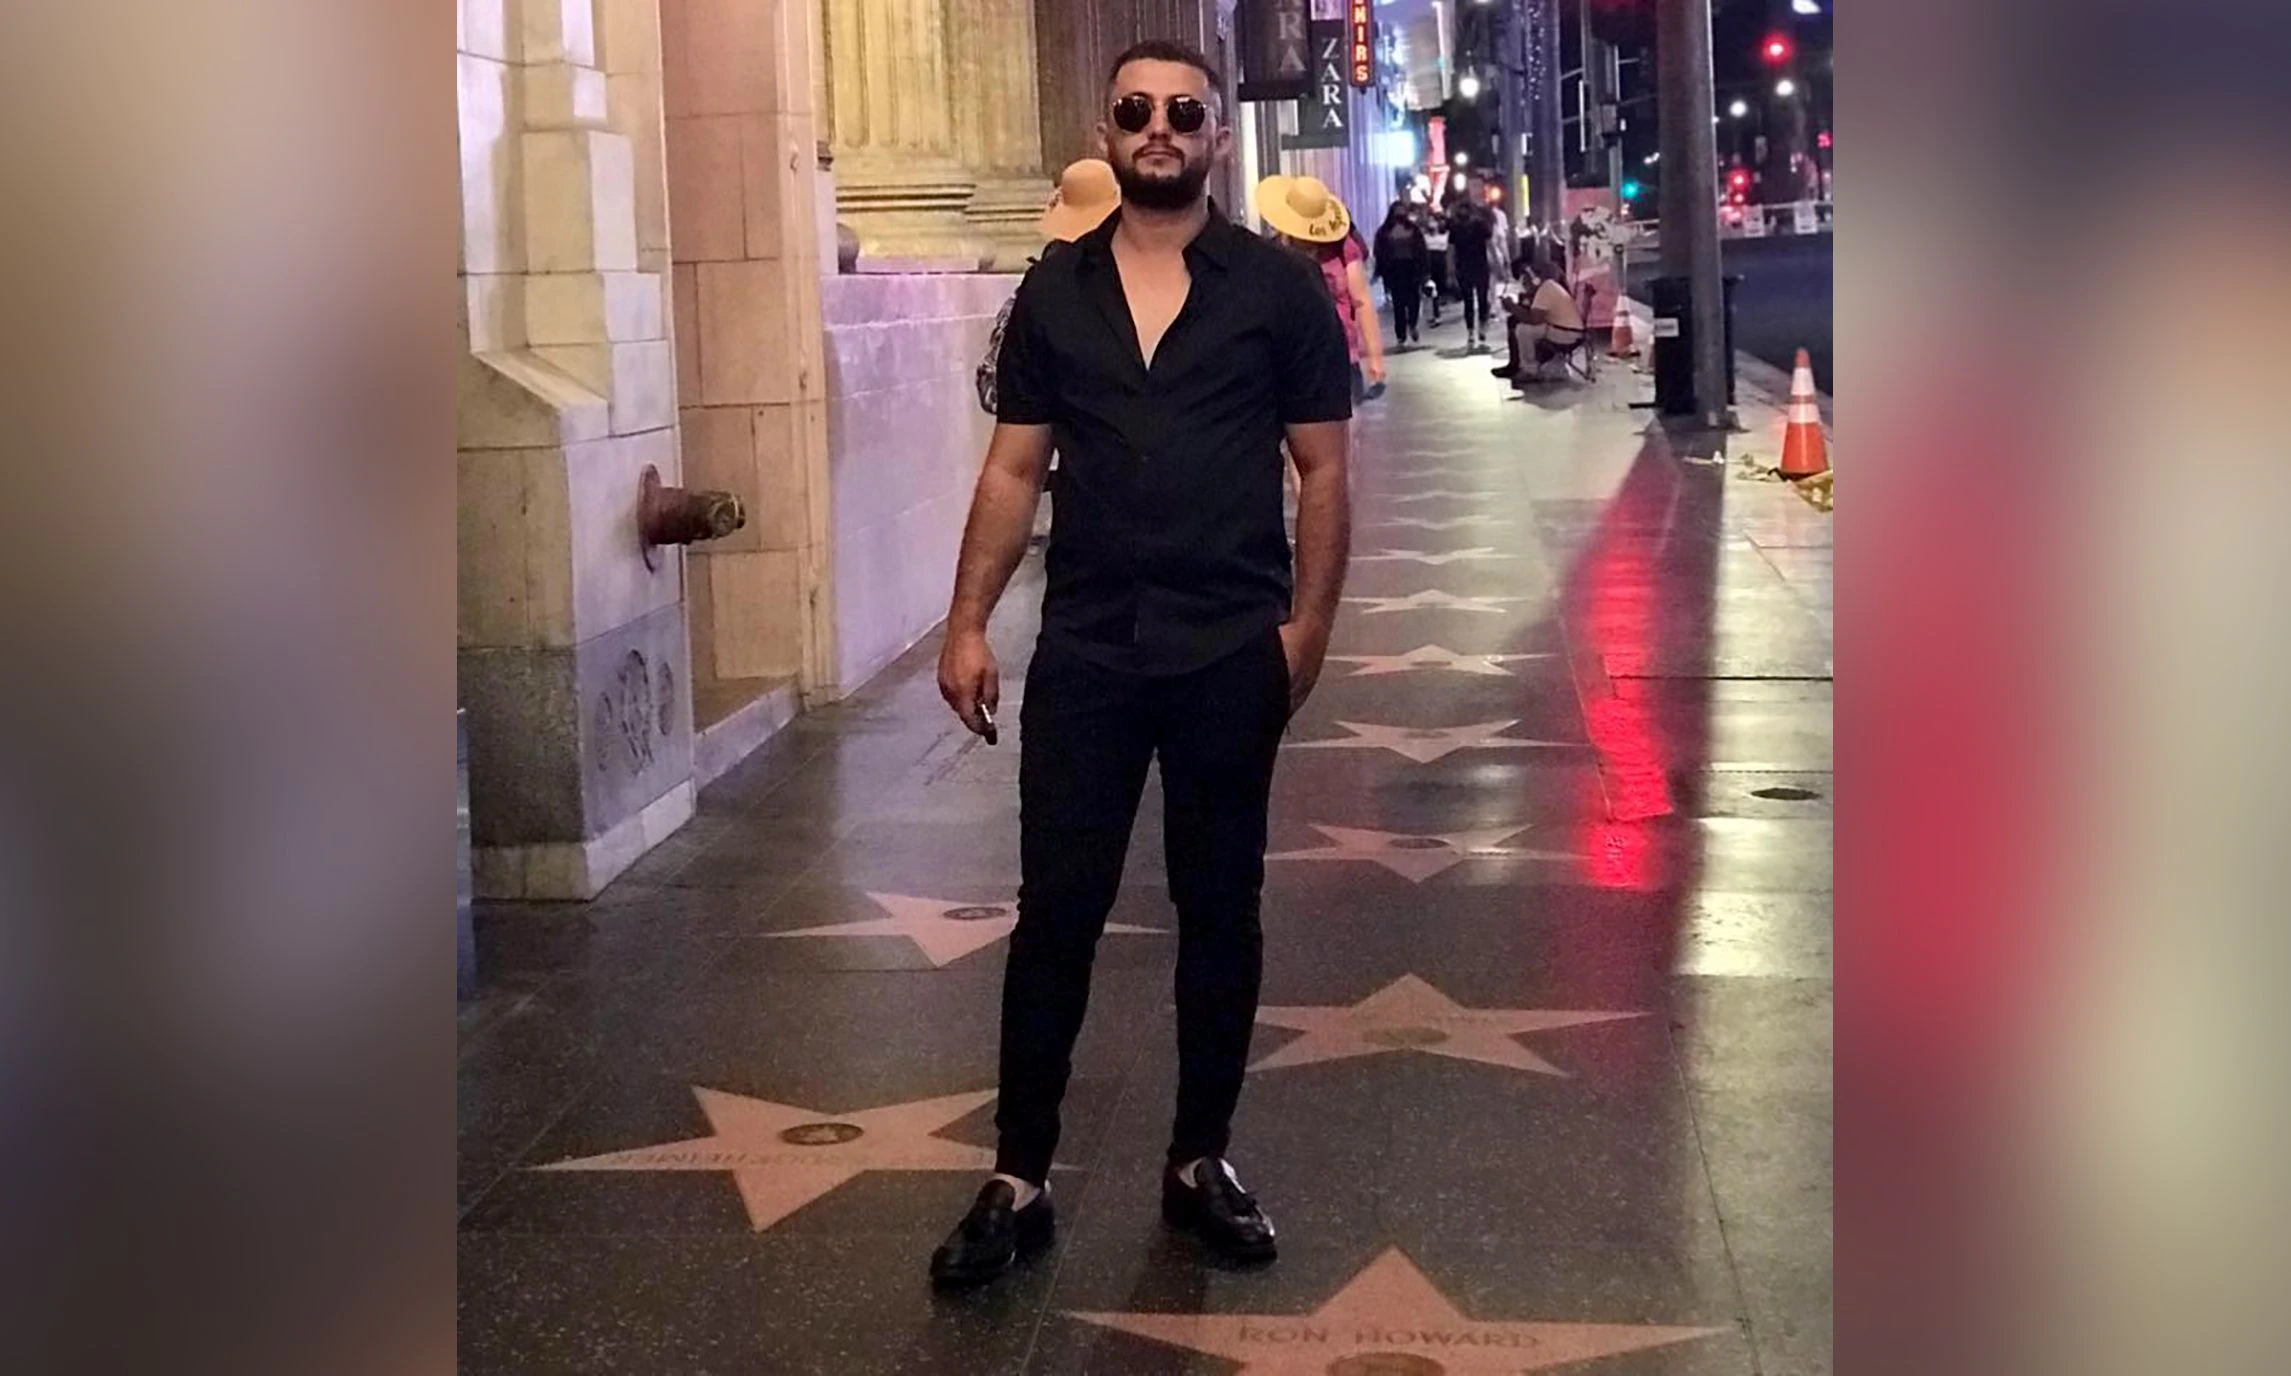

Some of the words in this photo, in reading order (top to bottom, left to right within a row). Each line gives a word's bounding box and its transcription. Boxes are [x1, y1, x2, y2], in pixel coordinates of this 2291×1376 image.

[1354, 0, 1369, 81] NIRS
[1322, 38, 1343, 128] ZARA
[1238, 1325, 1329, 1344] RON
[1354, 1328, 1541, 1349] HOWARD
